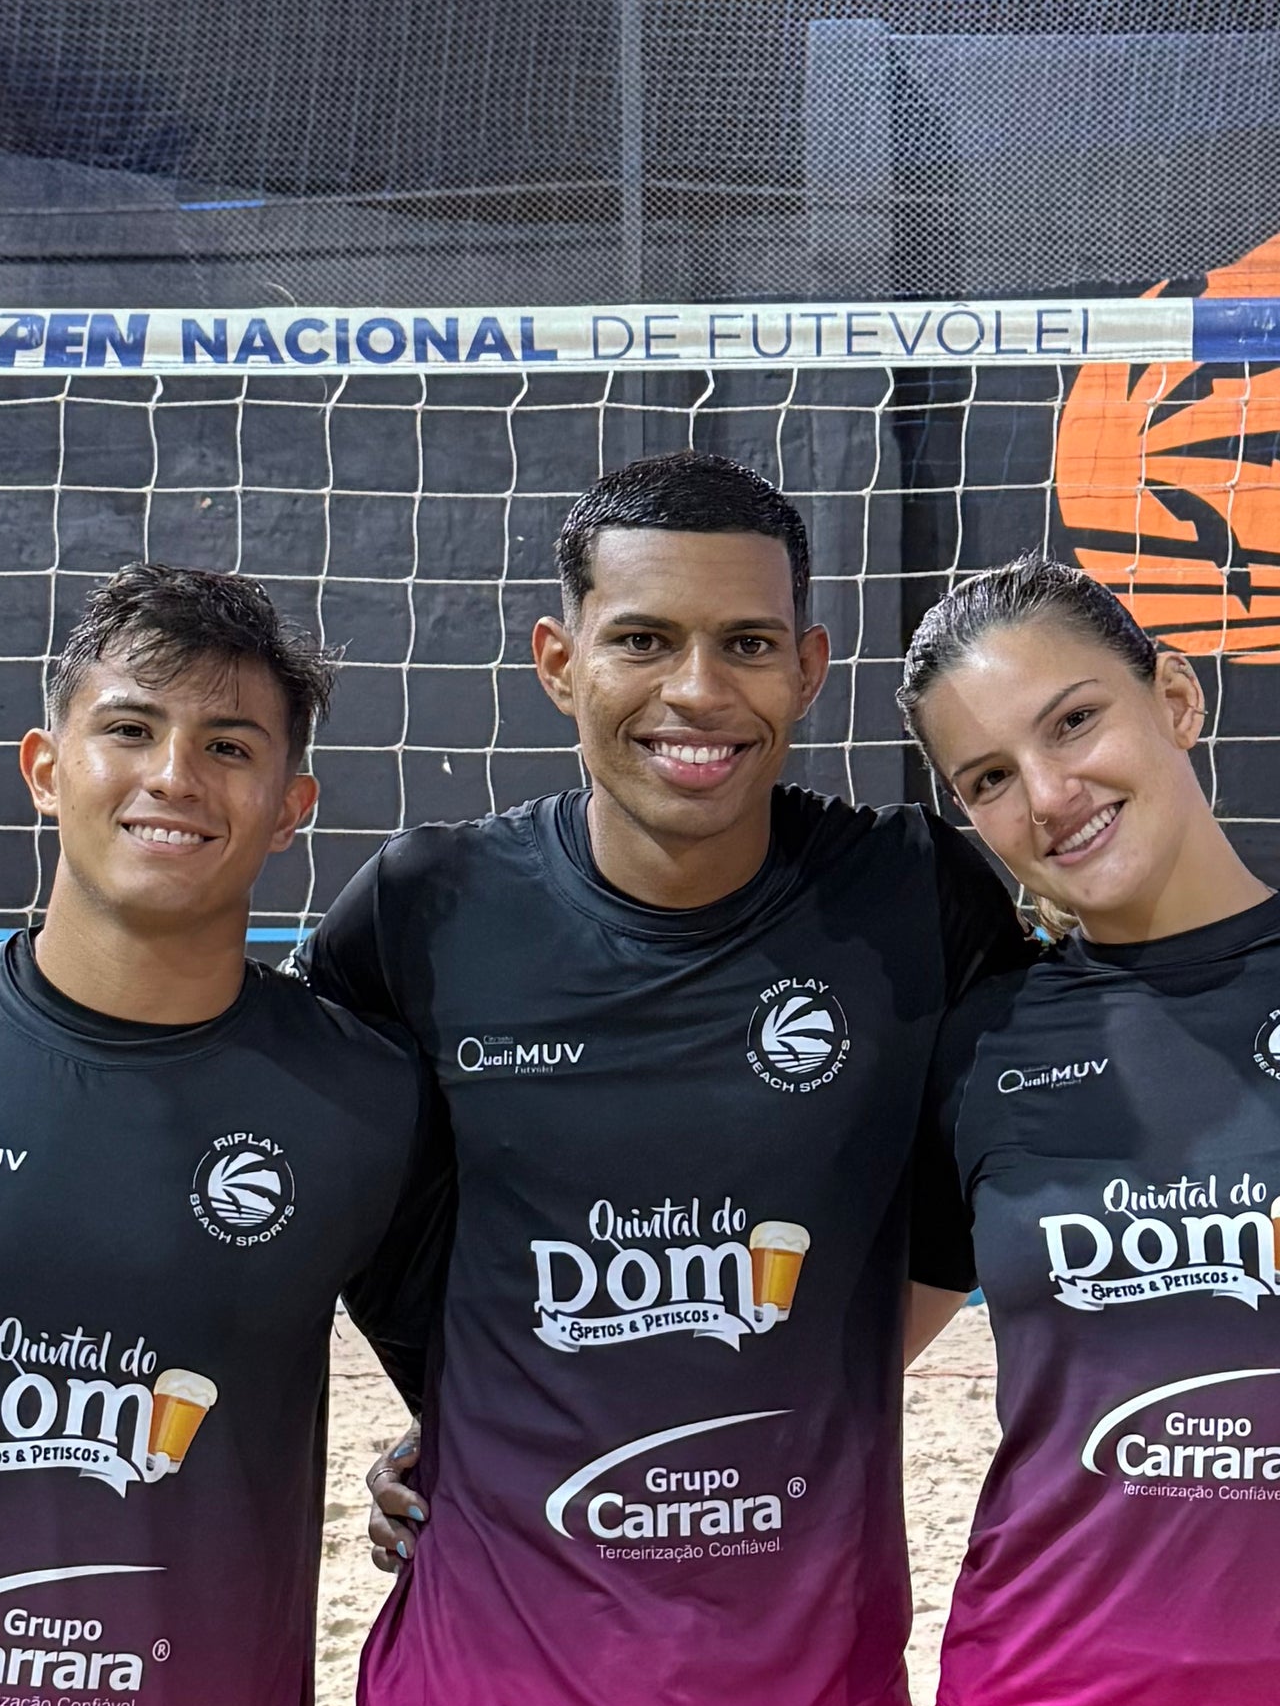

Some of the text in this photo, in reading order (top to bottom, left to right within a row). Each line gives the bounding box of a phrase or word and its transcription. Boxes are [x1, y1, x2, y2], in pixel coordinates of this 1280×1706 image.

[182, 316, 559, 365] NACIONAL
[592, 315, 679, 359] DE
[709, 302, 1090, 358] FUTEVÔLEI
[760, 977, 829, 1003] RIPLAY
[746, 1039, 850, 1092] BEACH SPORTS
[213, 1133, 284, 1156] RIPLAY
[1103, 1173, 1267, 1211] Quintal do
[190, 1193, 295, 1246] BEACH SPORTS
[589, 1197, 746, 1243] Quintal do
[531, 1241, 779, 1334] Dom
[1161, 1272, 1228, 1291] PETISCOS
[642, 1310, 709, 1331] PETISCOS
[121, 1337, 157, 1377] do
[1165, 1412, 1252, 1441] Grupo
[31, 1445, 100, 1463] PETISCOS
[645, 1467, 739, 1495] Grupo
[1123, 1481, 1214, 1501] Terceirização
[587, 1492, 782, 1539] Carrara
[596, 1544, 703, 1563] Terceirização
[4, 1609, 102, 1646] Grupo
